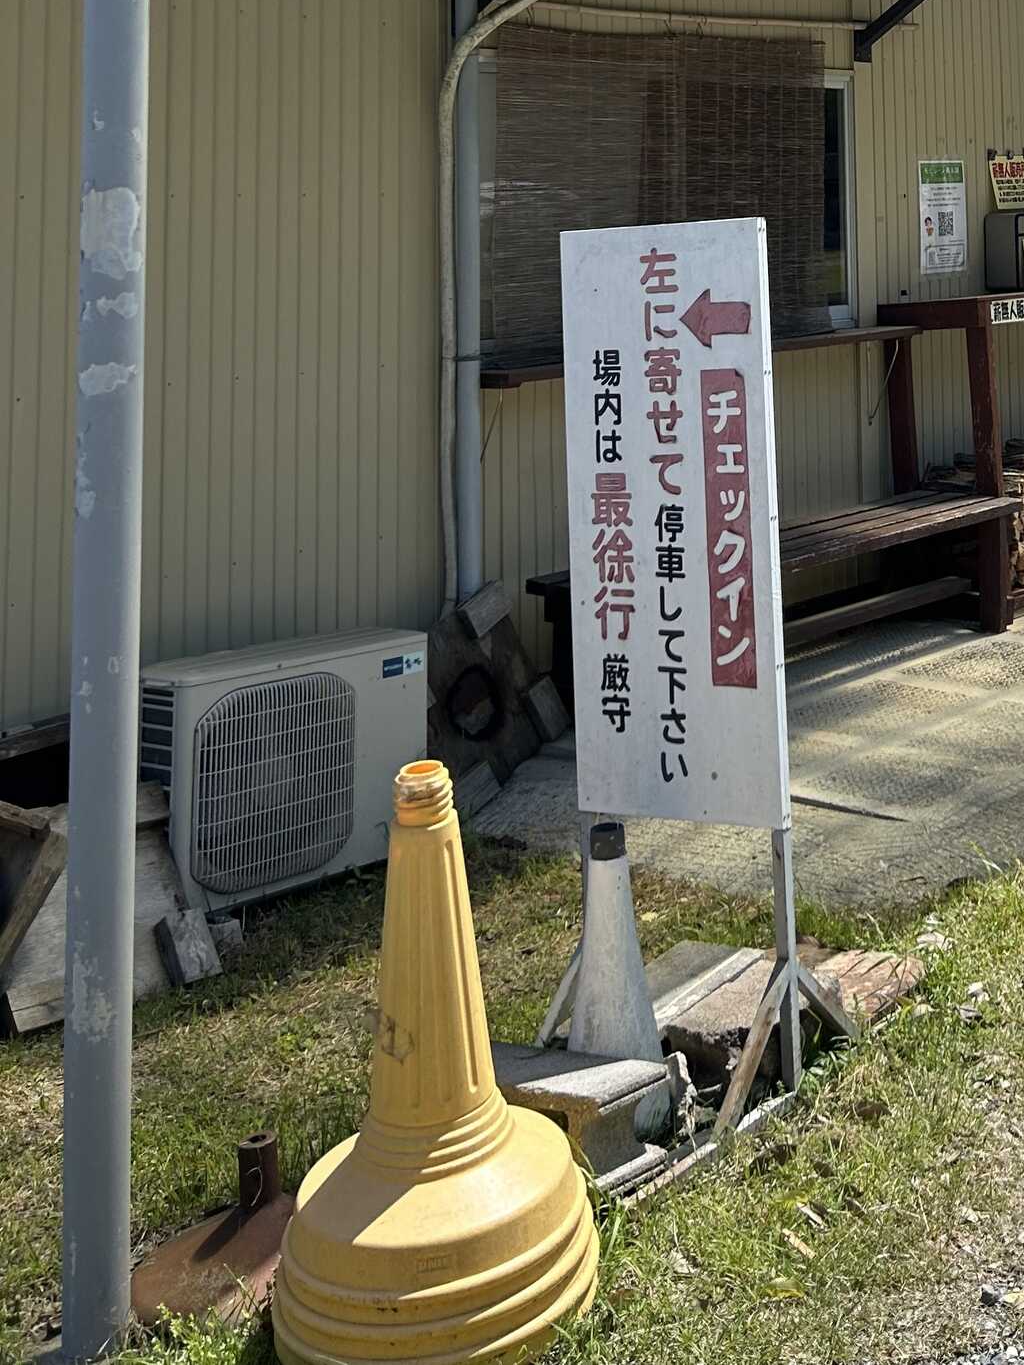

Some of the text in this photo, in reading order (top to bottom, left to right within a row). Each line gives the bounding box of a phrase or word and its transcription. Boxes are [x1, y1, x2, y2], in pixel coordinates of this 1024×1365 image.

[706, 389, 752, 666] チェックイン
